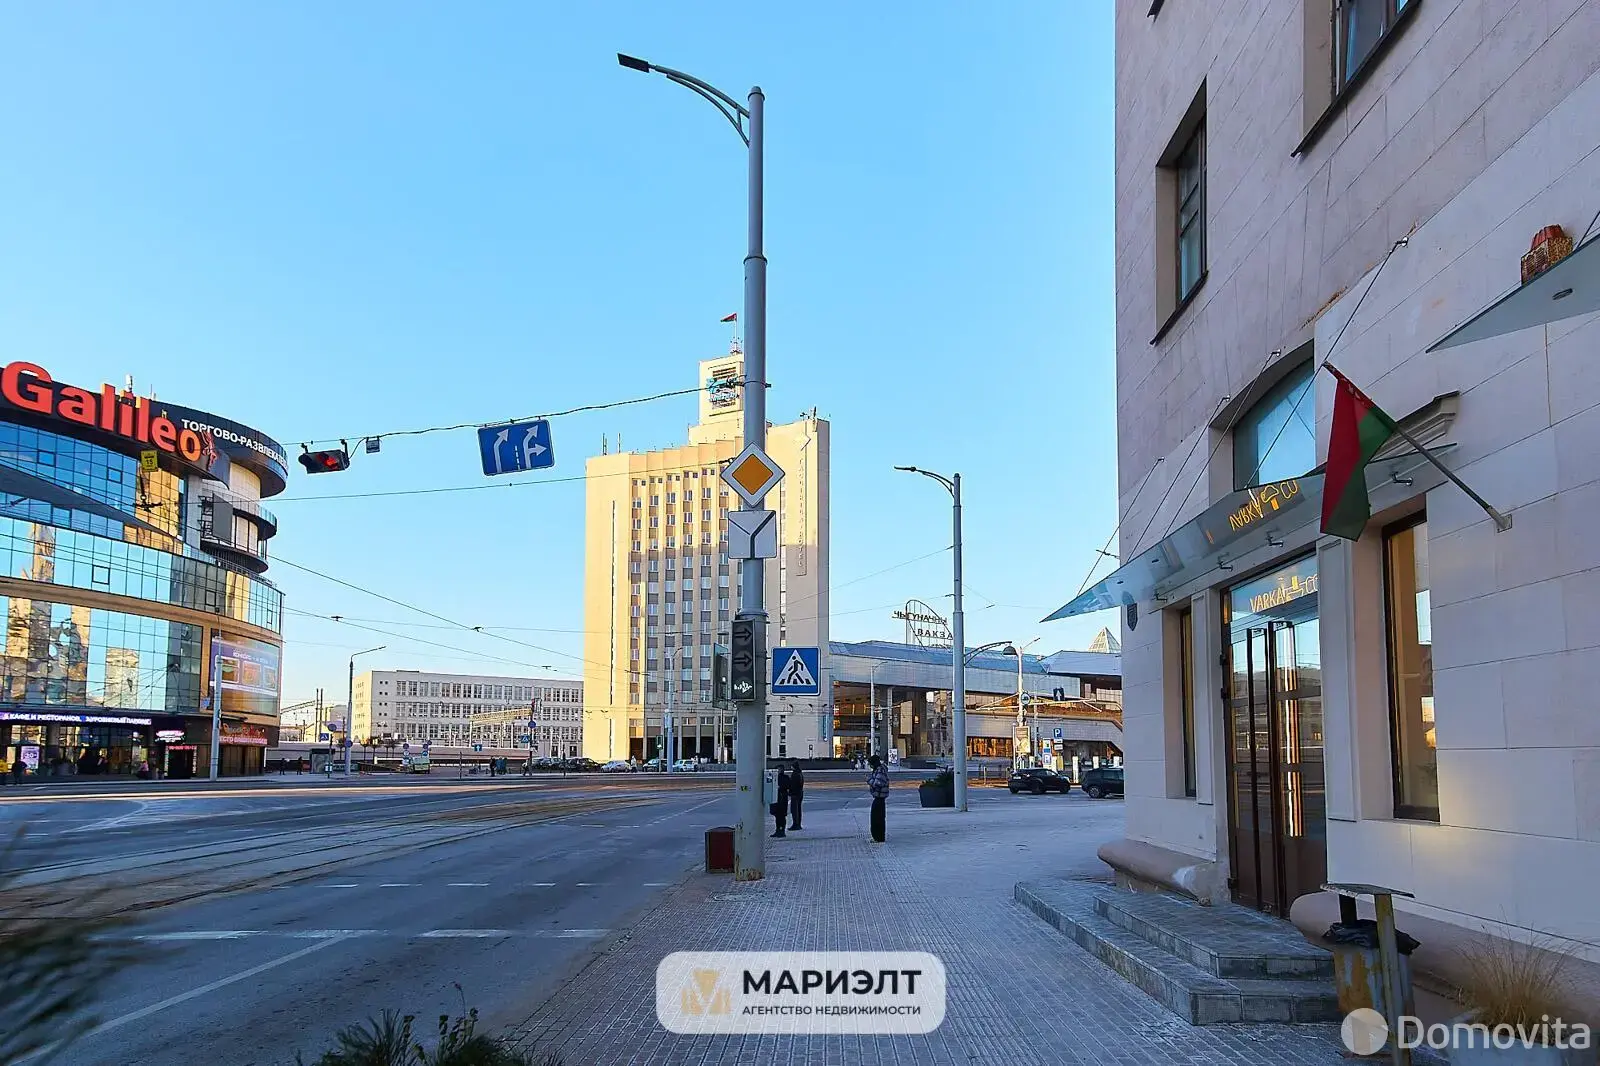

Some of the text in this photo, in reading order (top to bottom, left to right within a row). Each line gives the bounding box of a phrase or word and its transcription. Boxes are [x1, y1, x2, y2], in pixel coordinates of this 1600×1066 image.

[1, 361, 202, 463] Galileo
[1250, 587, 1285, 613] VARKA
[917, 628, 953, 640] ВАКЗА
